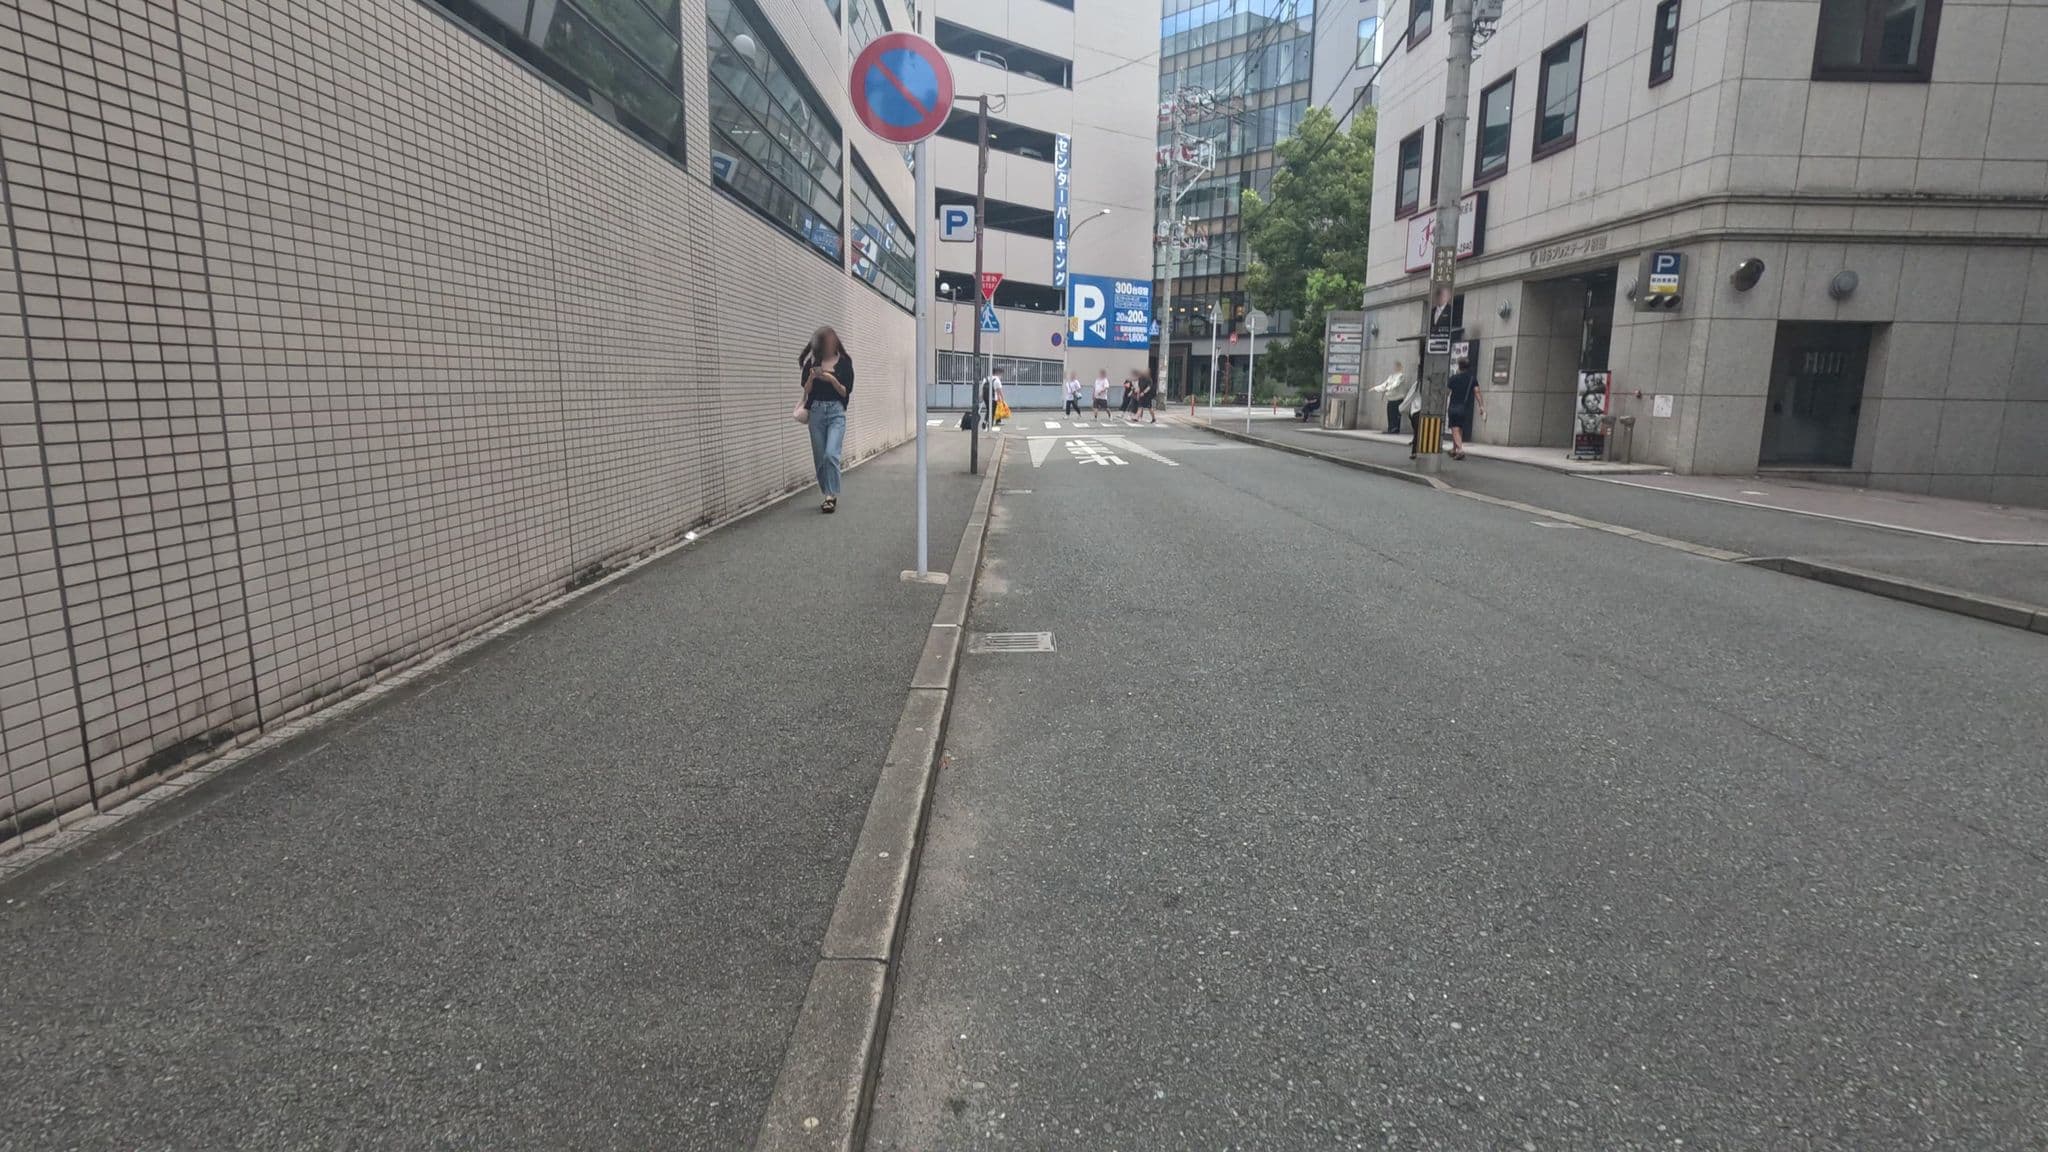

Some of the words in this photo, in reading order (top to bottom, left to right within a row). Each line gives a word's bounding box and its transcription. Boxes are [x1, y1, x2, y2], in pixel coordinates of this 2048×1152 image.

[946, 210, 969, 235] P
[1055, 138, 1068, 286] センターパーキング
[1657, 255, 1676, 273] P
[1074, 284, 1105, 341] P
[1096, 324, 1105, 333] IN
